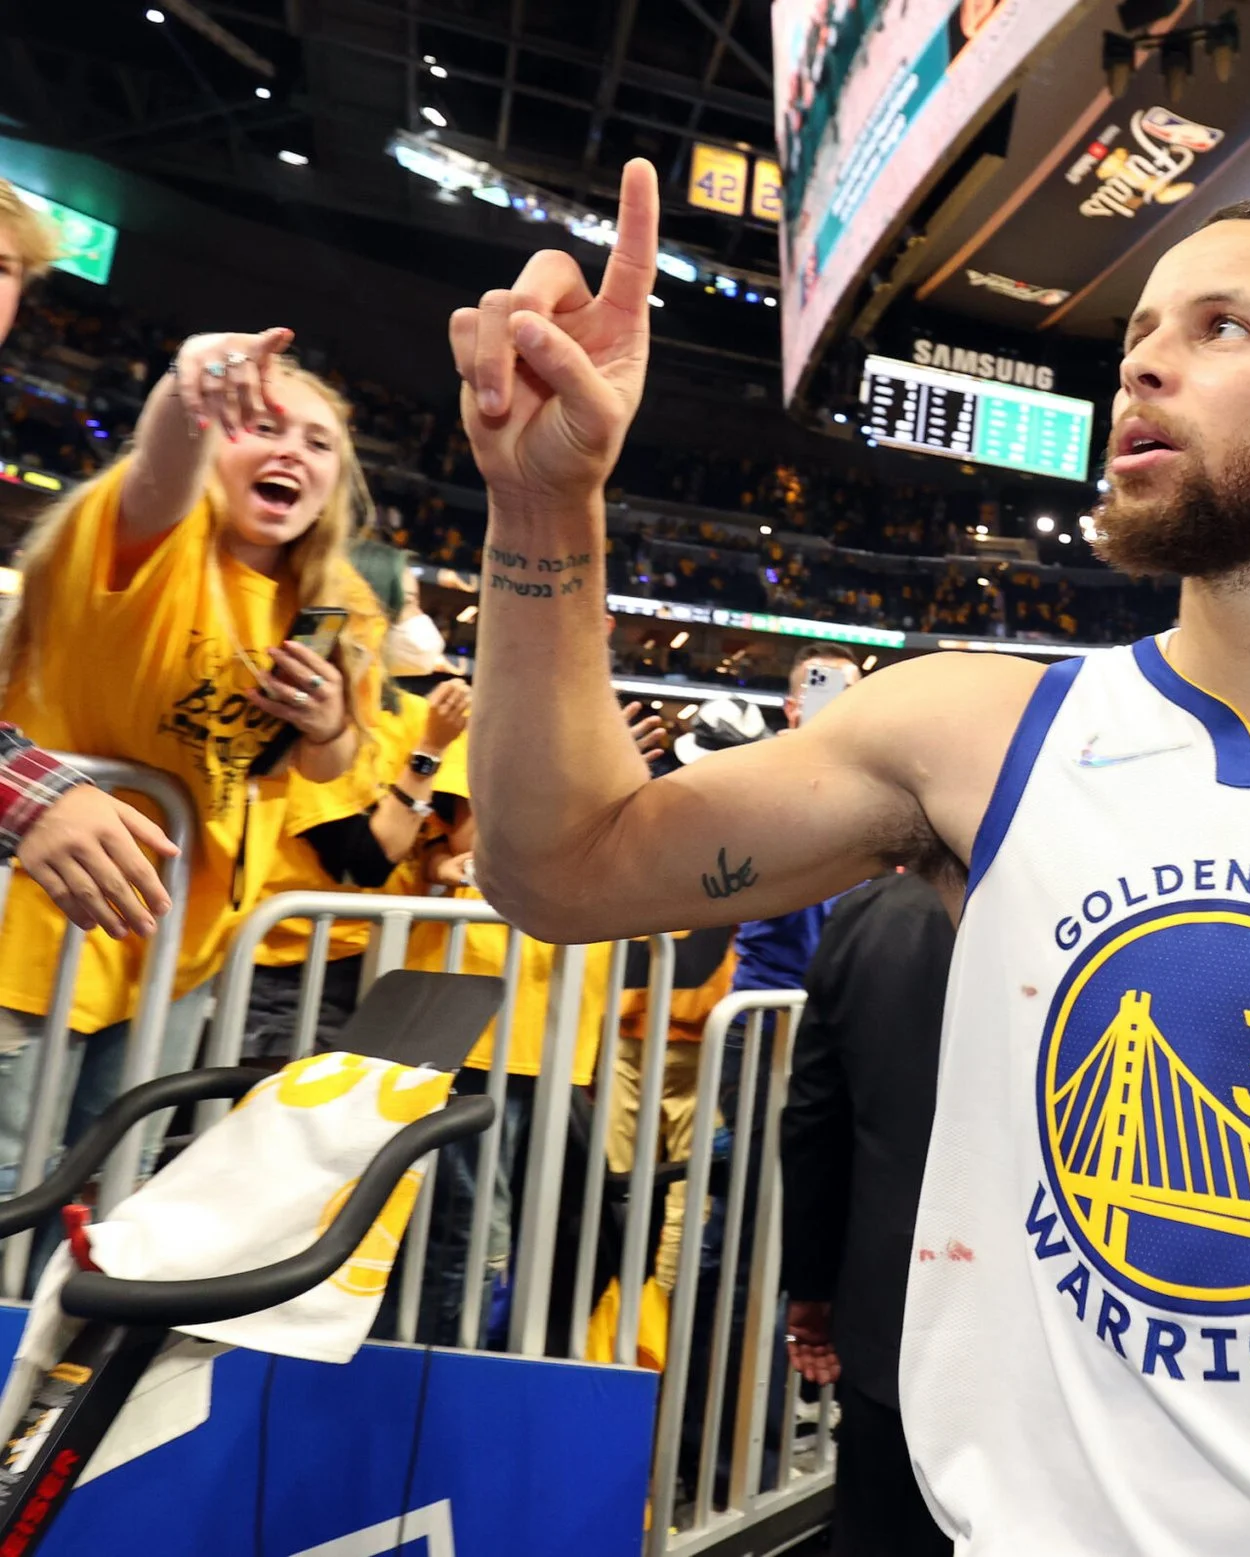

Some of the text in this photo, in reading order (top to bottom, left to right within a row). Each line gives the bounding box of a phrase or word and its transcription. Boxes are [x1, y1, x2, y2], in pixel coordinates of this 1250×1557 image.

[1079, 109, 1195, 219] Finals
[696, 171, 738, 204] 42
[761, 183, 784, 212] 2
[913, 338, 1055, 391] SAMSUNG
